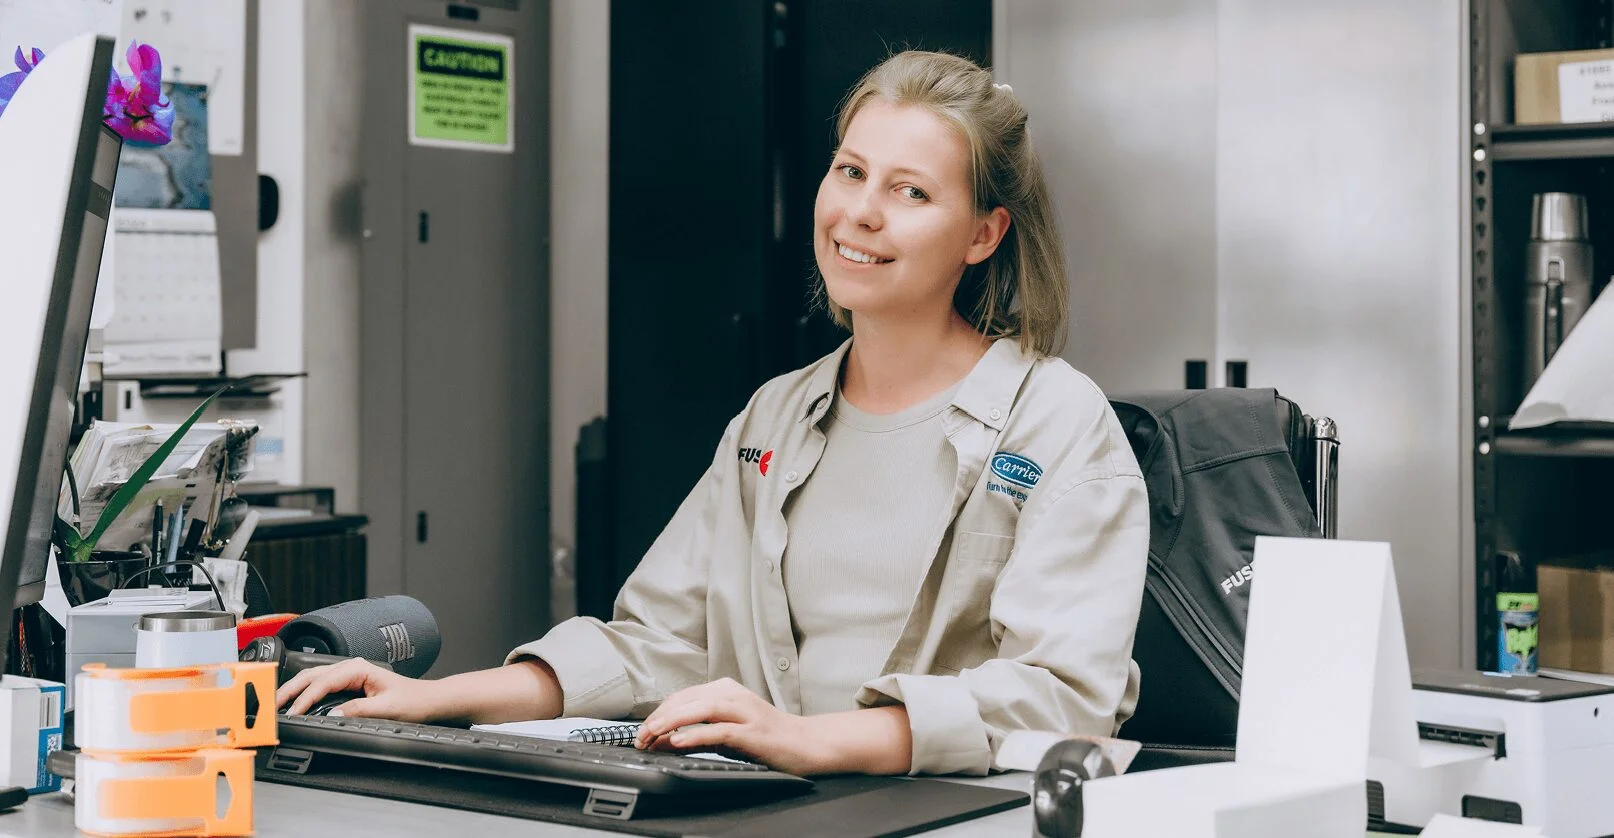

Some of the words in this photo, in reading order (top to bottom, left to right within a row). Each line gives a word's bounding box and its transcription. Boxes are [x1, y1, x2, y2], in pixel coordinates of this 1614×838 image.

[423, 47, 500, 73] CAUTION
[995, 457, 1041, 483] Carrier
[379, 622, 416, 664] JBL
